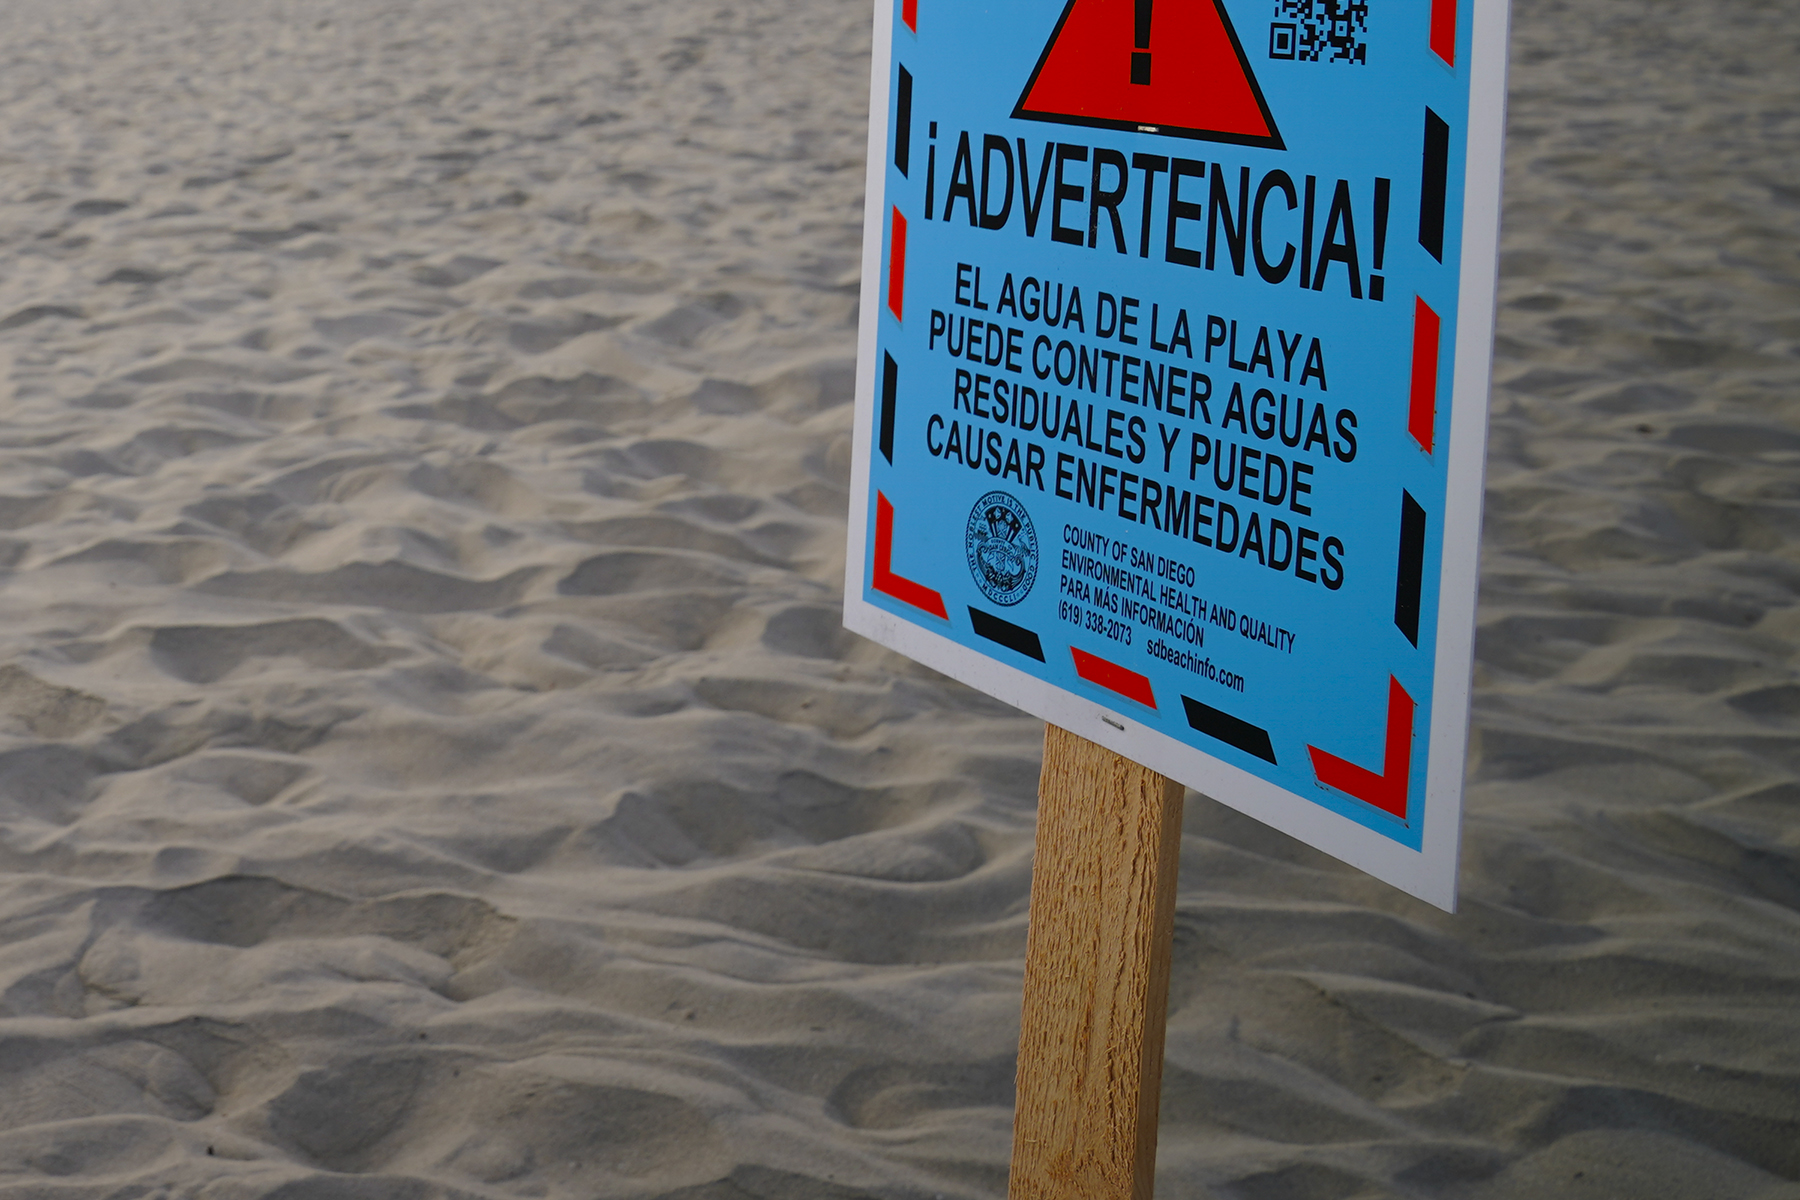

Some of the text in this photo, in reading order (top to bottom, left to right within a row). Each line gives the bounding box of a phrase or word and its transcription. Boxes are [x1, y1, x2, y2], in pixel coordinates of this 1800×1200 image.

[923, 121, 1392, 302] ¡ADVERTENCIA!
[955, 262, 1328, 392] EL AGUA DE LA PLAYA
[929, 309, 1358, 464] PUEDE CONTENER AGUAS
[953, 368, 1314, 517] RESIDUALES Y PUEDE
[926, 413, 1345, 591] CAUSAR ENFERMEDADES
[1063, 523, 1195, 588] COUNTY OF SAN DIEGO
[1022, 565, 1035, 590] GOOD
[1060, 574, 1204, 648] PARA MÁS INFORMACIÓN
[1061, 548, 1157, 602] ENVIRONMENTAL
[1159, 584, 1207, 621] HEALTH
[1209, 604, 1236, 632] AND
[1239, 615, 1296, 654] QUALITY
[1058, 600, 1245, 693] (619) 338-2073 sdbeachinfo.com
